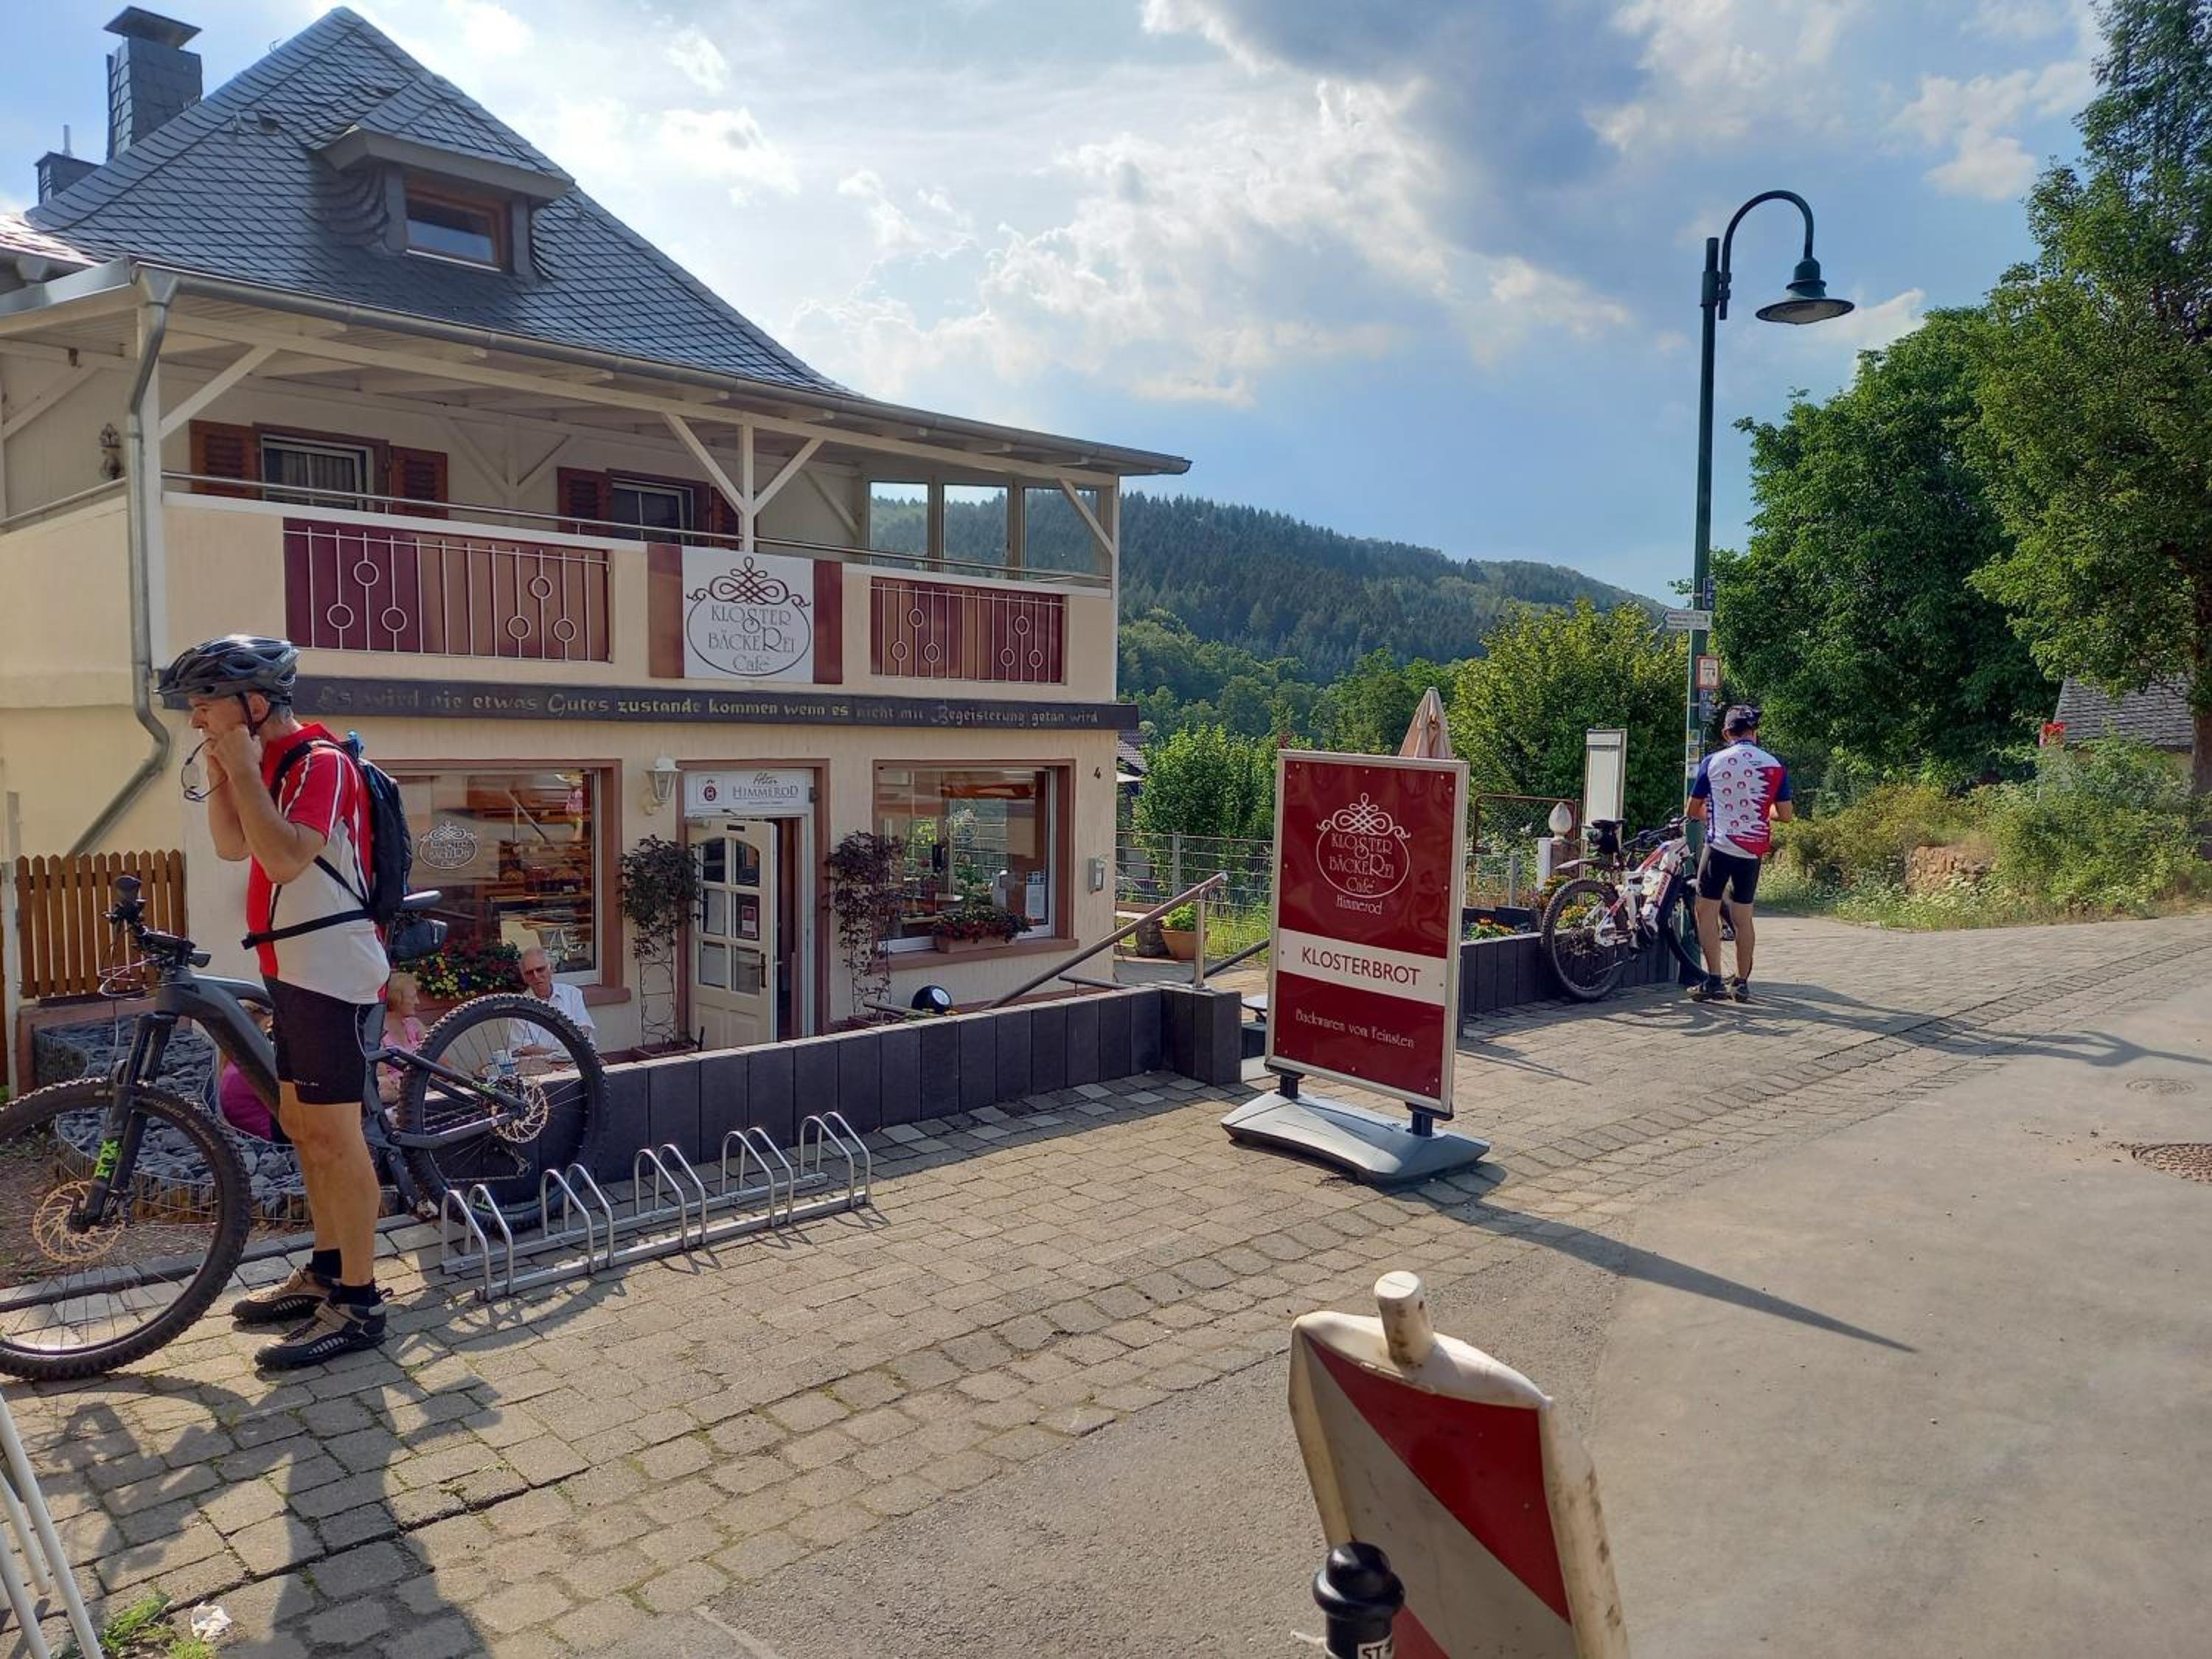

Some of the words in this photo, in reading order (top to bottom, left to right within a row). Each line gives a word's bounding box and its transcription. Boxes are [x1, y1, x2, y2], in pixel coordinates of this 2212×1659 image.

[712, 605, 791, 634] KLOSTER
[709, 627, 795, 653] BÄCKEREI
[733, 655, 771, 672] Café
[473, 697, 538, 709] etwas
[547, 693, 609, 717] Gutes
[618, 698, 700, 713] zustande
[709, 698, 778, 714] kommen
[785, 703, 825, 716] wenn
[831, 706, 849, 717] es
[931, 705, 1025, 726] Begeisterung
[1032, 709, 1064, 726] getan
[1069, 708, 1097, 722] wird
[1093, 766, 1101, 779] 4
[732, 785, 799, 798] HIMMEROD
[1331, 832, 1393, 859] KLOSTER
[1329, 854, 1394, 879] BÄCKEREI
[1346, 877, 1375, 894] Café
[1336, 894, 1383, 915] Himmerod
[1301, 946, 1422, 986] KLOSTERBROT
[1295, 1008, 1346, 1032] Backwaren
[1371, 1026, 1416, 1048] Feinsten
[96, 1140, 119, 1178] FOX
